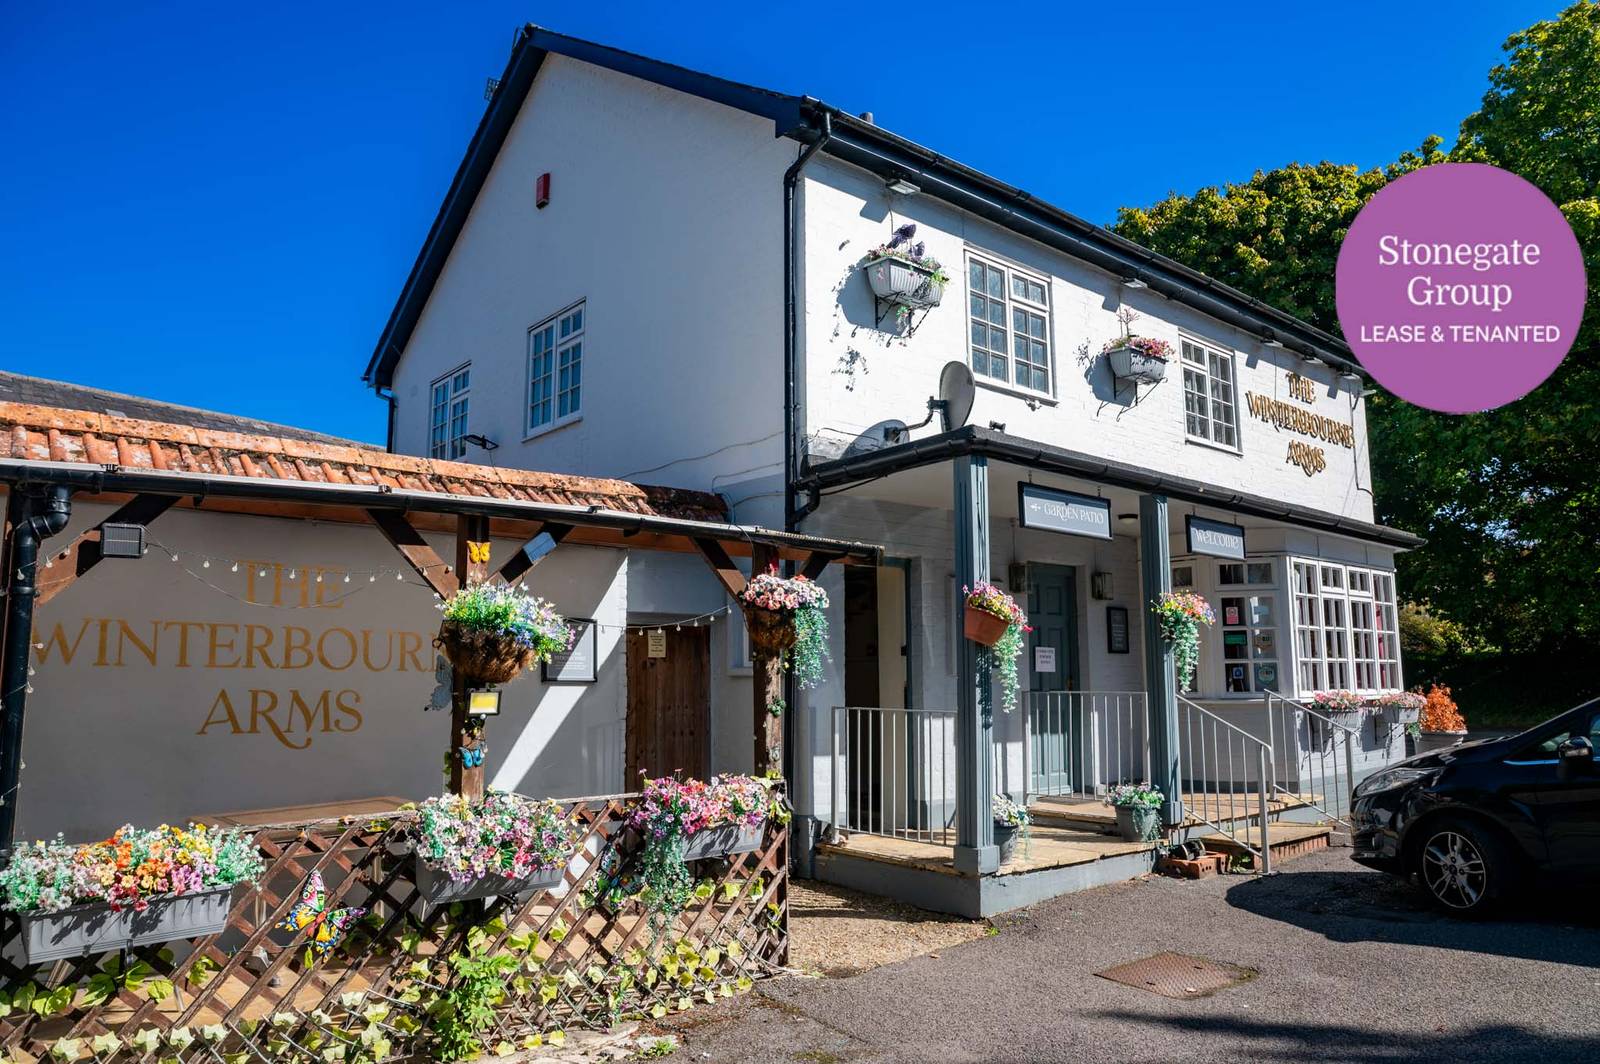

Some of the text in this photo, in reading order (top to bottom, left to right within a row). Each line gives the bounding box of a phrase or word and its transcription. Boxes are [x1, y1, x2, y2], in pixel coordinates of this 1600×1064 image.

[1285, 372, 1316, 405] THE
[1245, 390, 1355, 449] WINTERBOURNE
[1286, 440, 1326, 477] ARMS
[1080, 509, 1104, 525] PATIO
[239, 559, 345, 609] THE
[195, 689, 363, 750] ARMS
